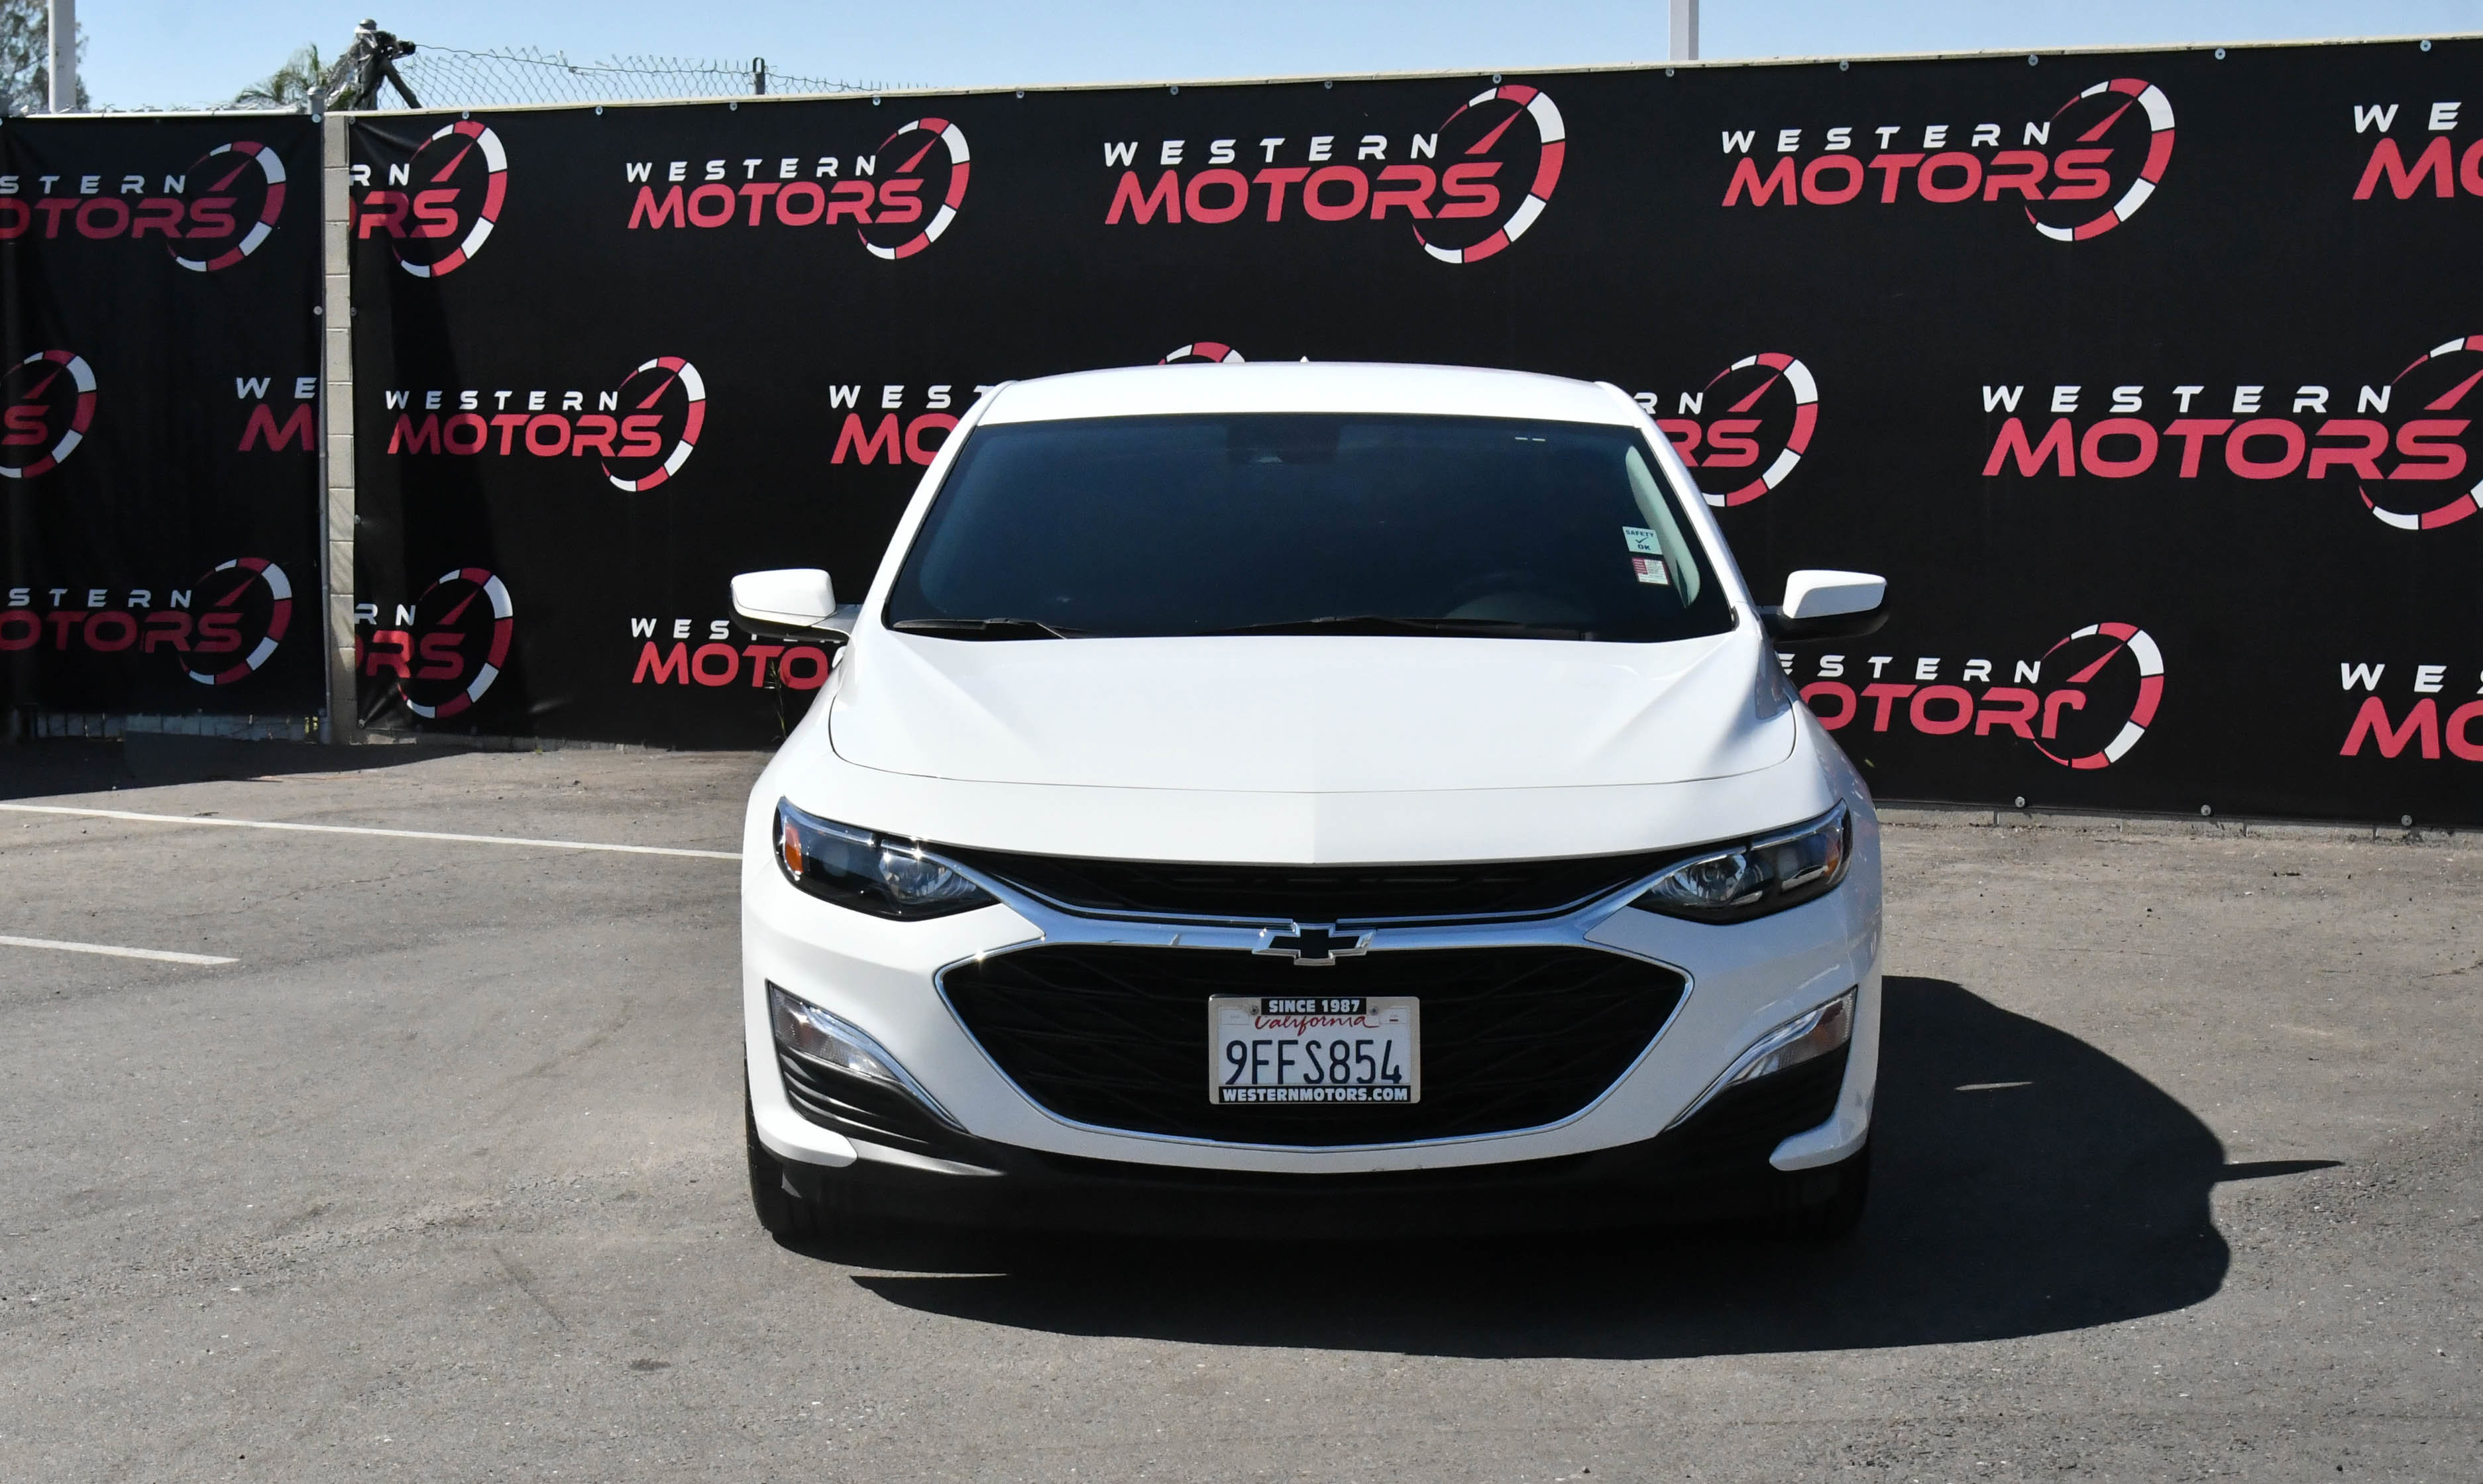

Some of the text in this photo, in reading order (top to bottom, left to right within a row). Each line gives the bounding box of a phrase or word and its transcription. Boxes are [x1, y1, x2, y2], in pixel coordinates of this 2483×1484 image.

[1104, 133, 1438, 167] WESTERN
[1722, 121, 2050, 154] WESTERN
[626, 155, 876, 182] WESTERN
[1722, 148, 2114, 207] MOTORS
[2352, 136, 2483, 200] M
[628, 178, 924, 229] MOTORS
[1105, 161, 1503, 225] MOTORS
[349, 188, 461, 239] RS
[385, 390, 618, 411] WESTERN
[1982, 386, 2392, 413] WESTERN
[387, 413, 663, 457] MOTORS
[1982, 417, 2471, 480] MOTORS
[355, 629, 466, 680] RS
[2341, 662, 2483, 694] WE
[1254, 1014, 1380, 1036] California
[1268, 999, 1360, 1013] SINCE 1987
[1225, 1039, 1402, 1085] 9FFS854
[1222, 1087, 1408, 1102] WESTERNMOTORS.COM
